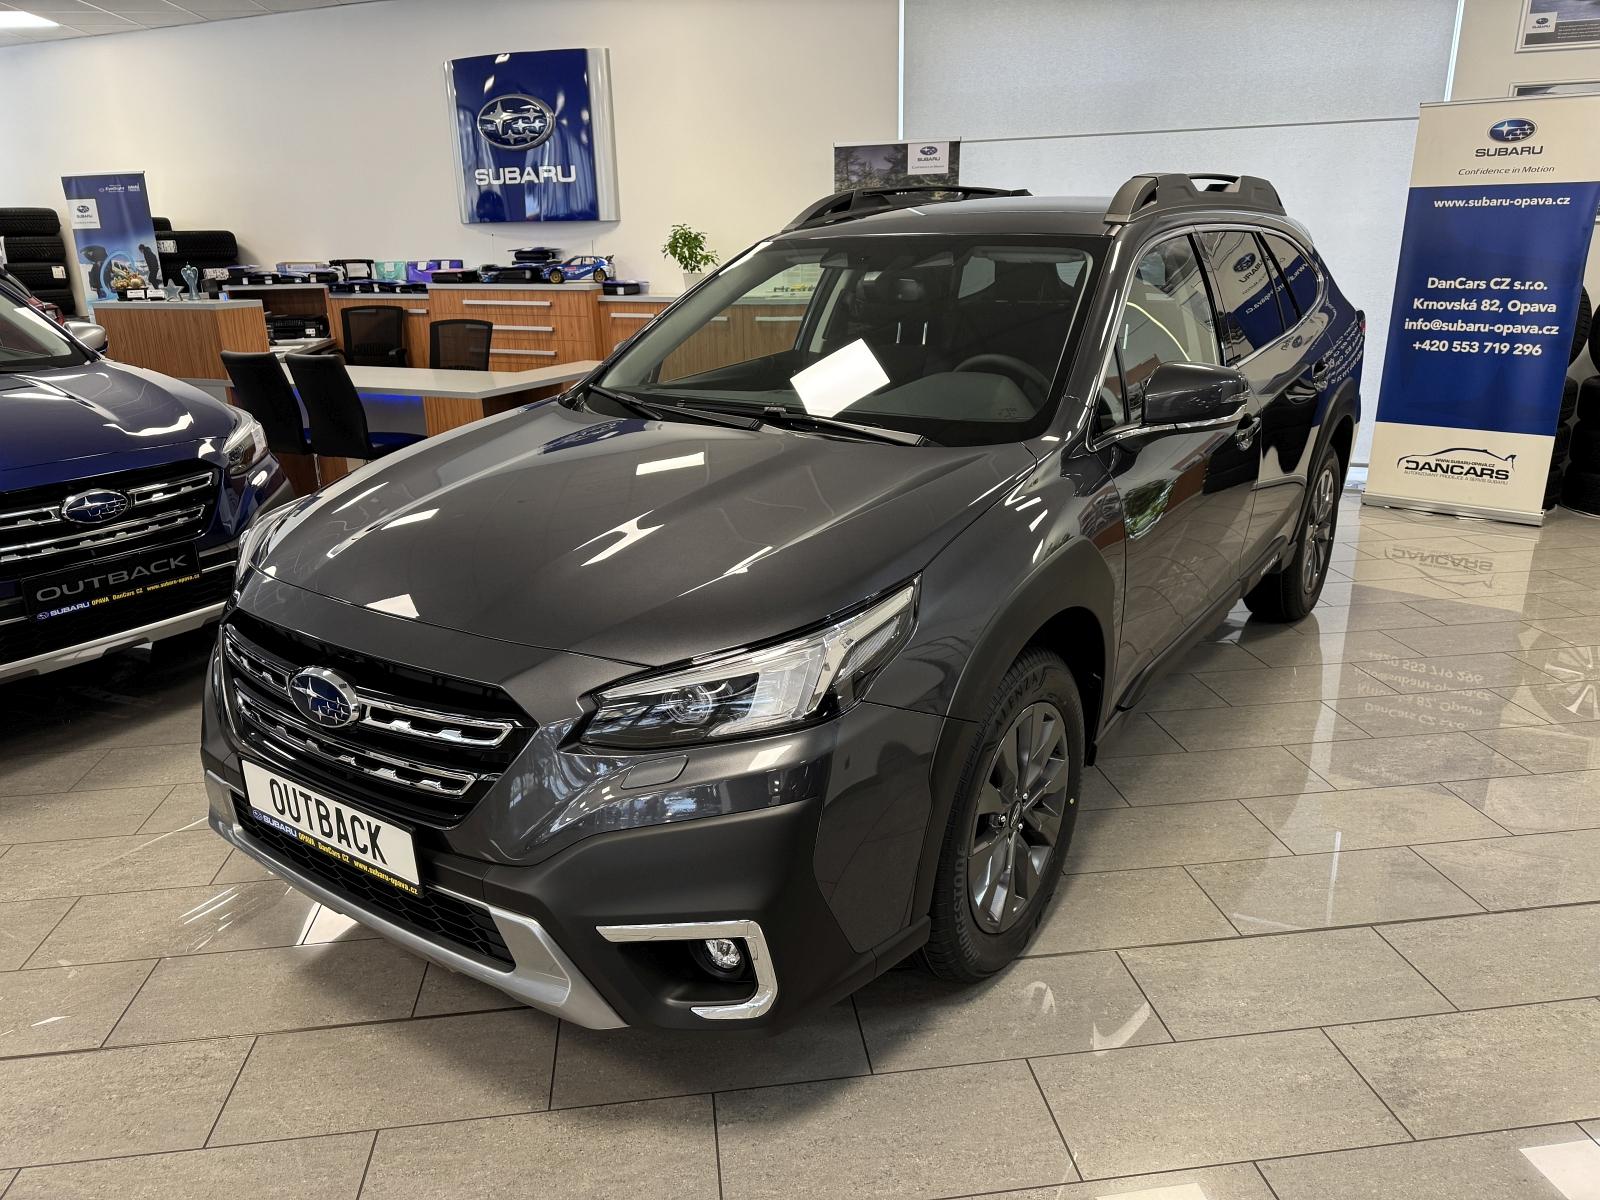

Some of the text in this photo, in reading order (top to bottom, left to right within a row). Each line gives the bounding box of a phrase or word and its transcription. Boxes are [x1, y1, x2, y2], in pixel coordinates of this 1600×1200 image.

[1475, 145, 1544, 158] SUBARU
[474, 164, 577, 186] SUBARU
[1458, 167, 1511, 176] Confidence
[1521, 165, 1555, 174] Motion
[1433, 195, 1571, 208] www.subaru-opava.cz
[1427, 277, 1548, 291] DanCars CZ s.r.o.
[1412, 298, 1557, 315] Krnovská 82, Opava
[1404, 318, 1560, 337] info@subaru-opava.cz
[1412, 339, 1543, 356] +420 553 719 296
[1404, 459, 1510, 481] DANCARS
[36, 554, 190, 602] OUTBACK
[50, 601, 90, 617] SUBARU
[91, 596, 110, 606] OPAVA
[112, 590, 135, 600] DanCars
[135, 587, 144, 595] CZ
[269, 777, 388, 866] OUTBACK
[263, 815, 297, 837] SUBARU
[298, 832, 316, 847] OPAVA
[317, 841, 341, 859] DanCars
[341, 853, 350, 863] CZ
